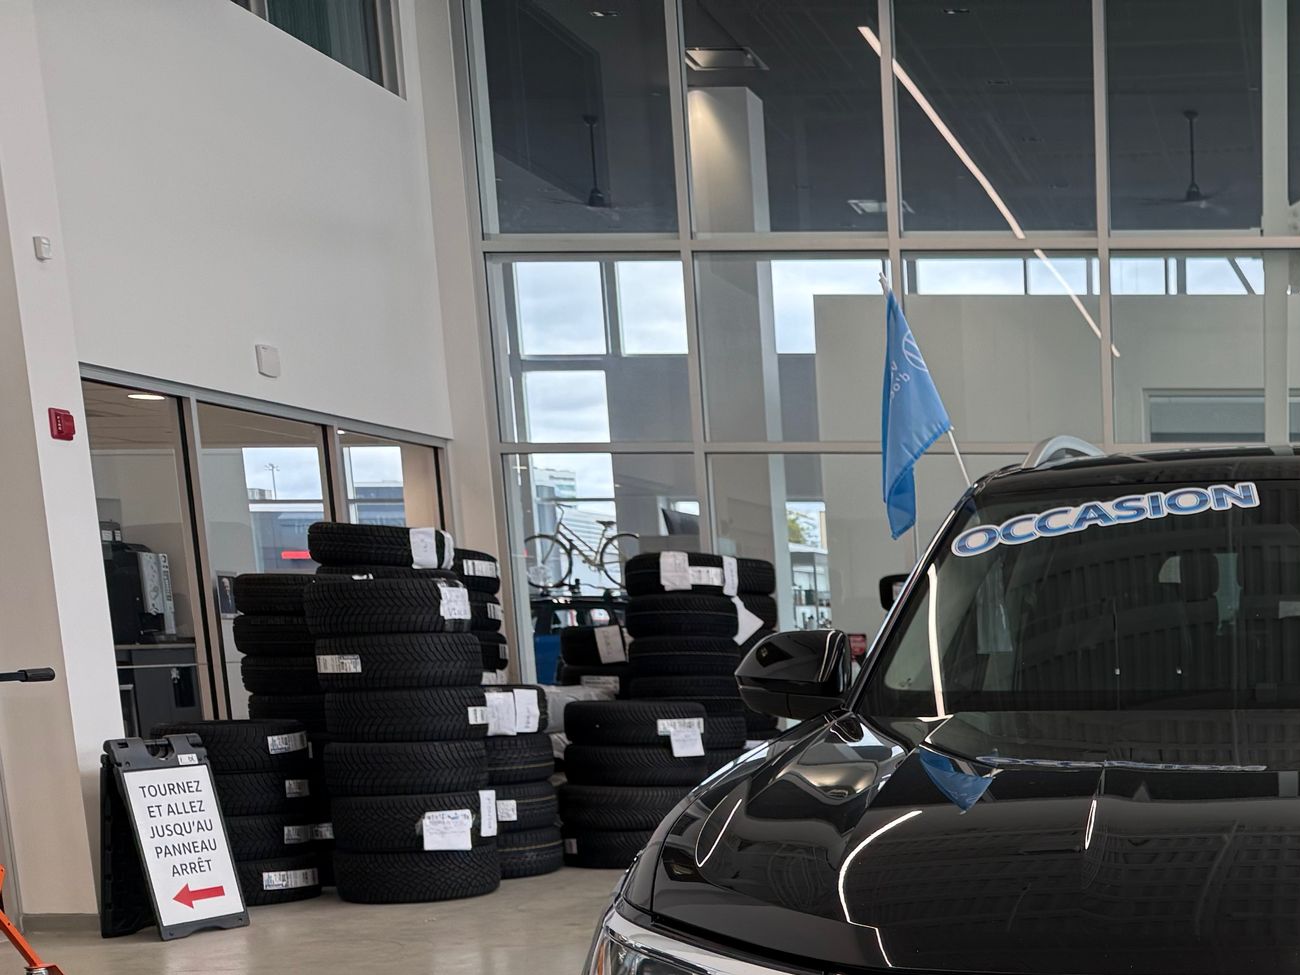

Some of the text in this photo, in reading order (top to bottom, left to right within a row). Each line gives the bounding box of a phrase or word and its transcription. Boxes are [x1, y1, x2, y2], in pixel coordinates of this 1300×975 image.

[952, 483, 1259, 556] OCCASION
[139, 780, 202, 798] TOURNEZ
[147, 800, 206, 818] ET ALLEZ
[149, 818, 213, 839] JUSQU'AU
[155, 838, 217, 859] PANNEAU
[171, 857, 212, 878] ARRÊT
